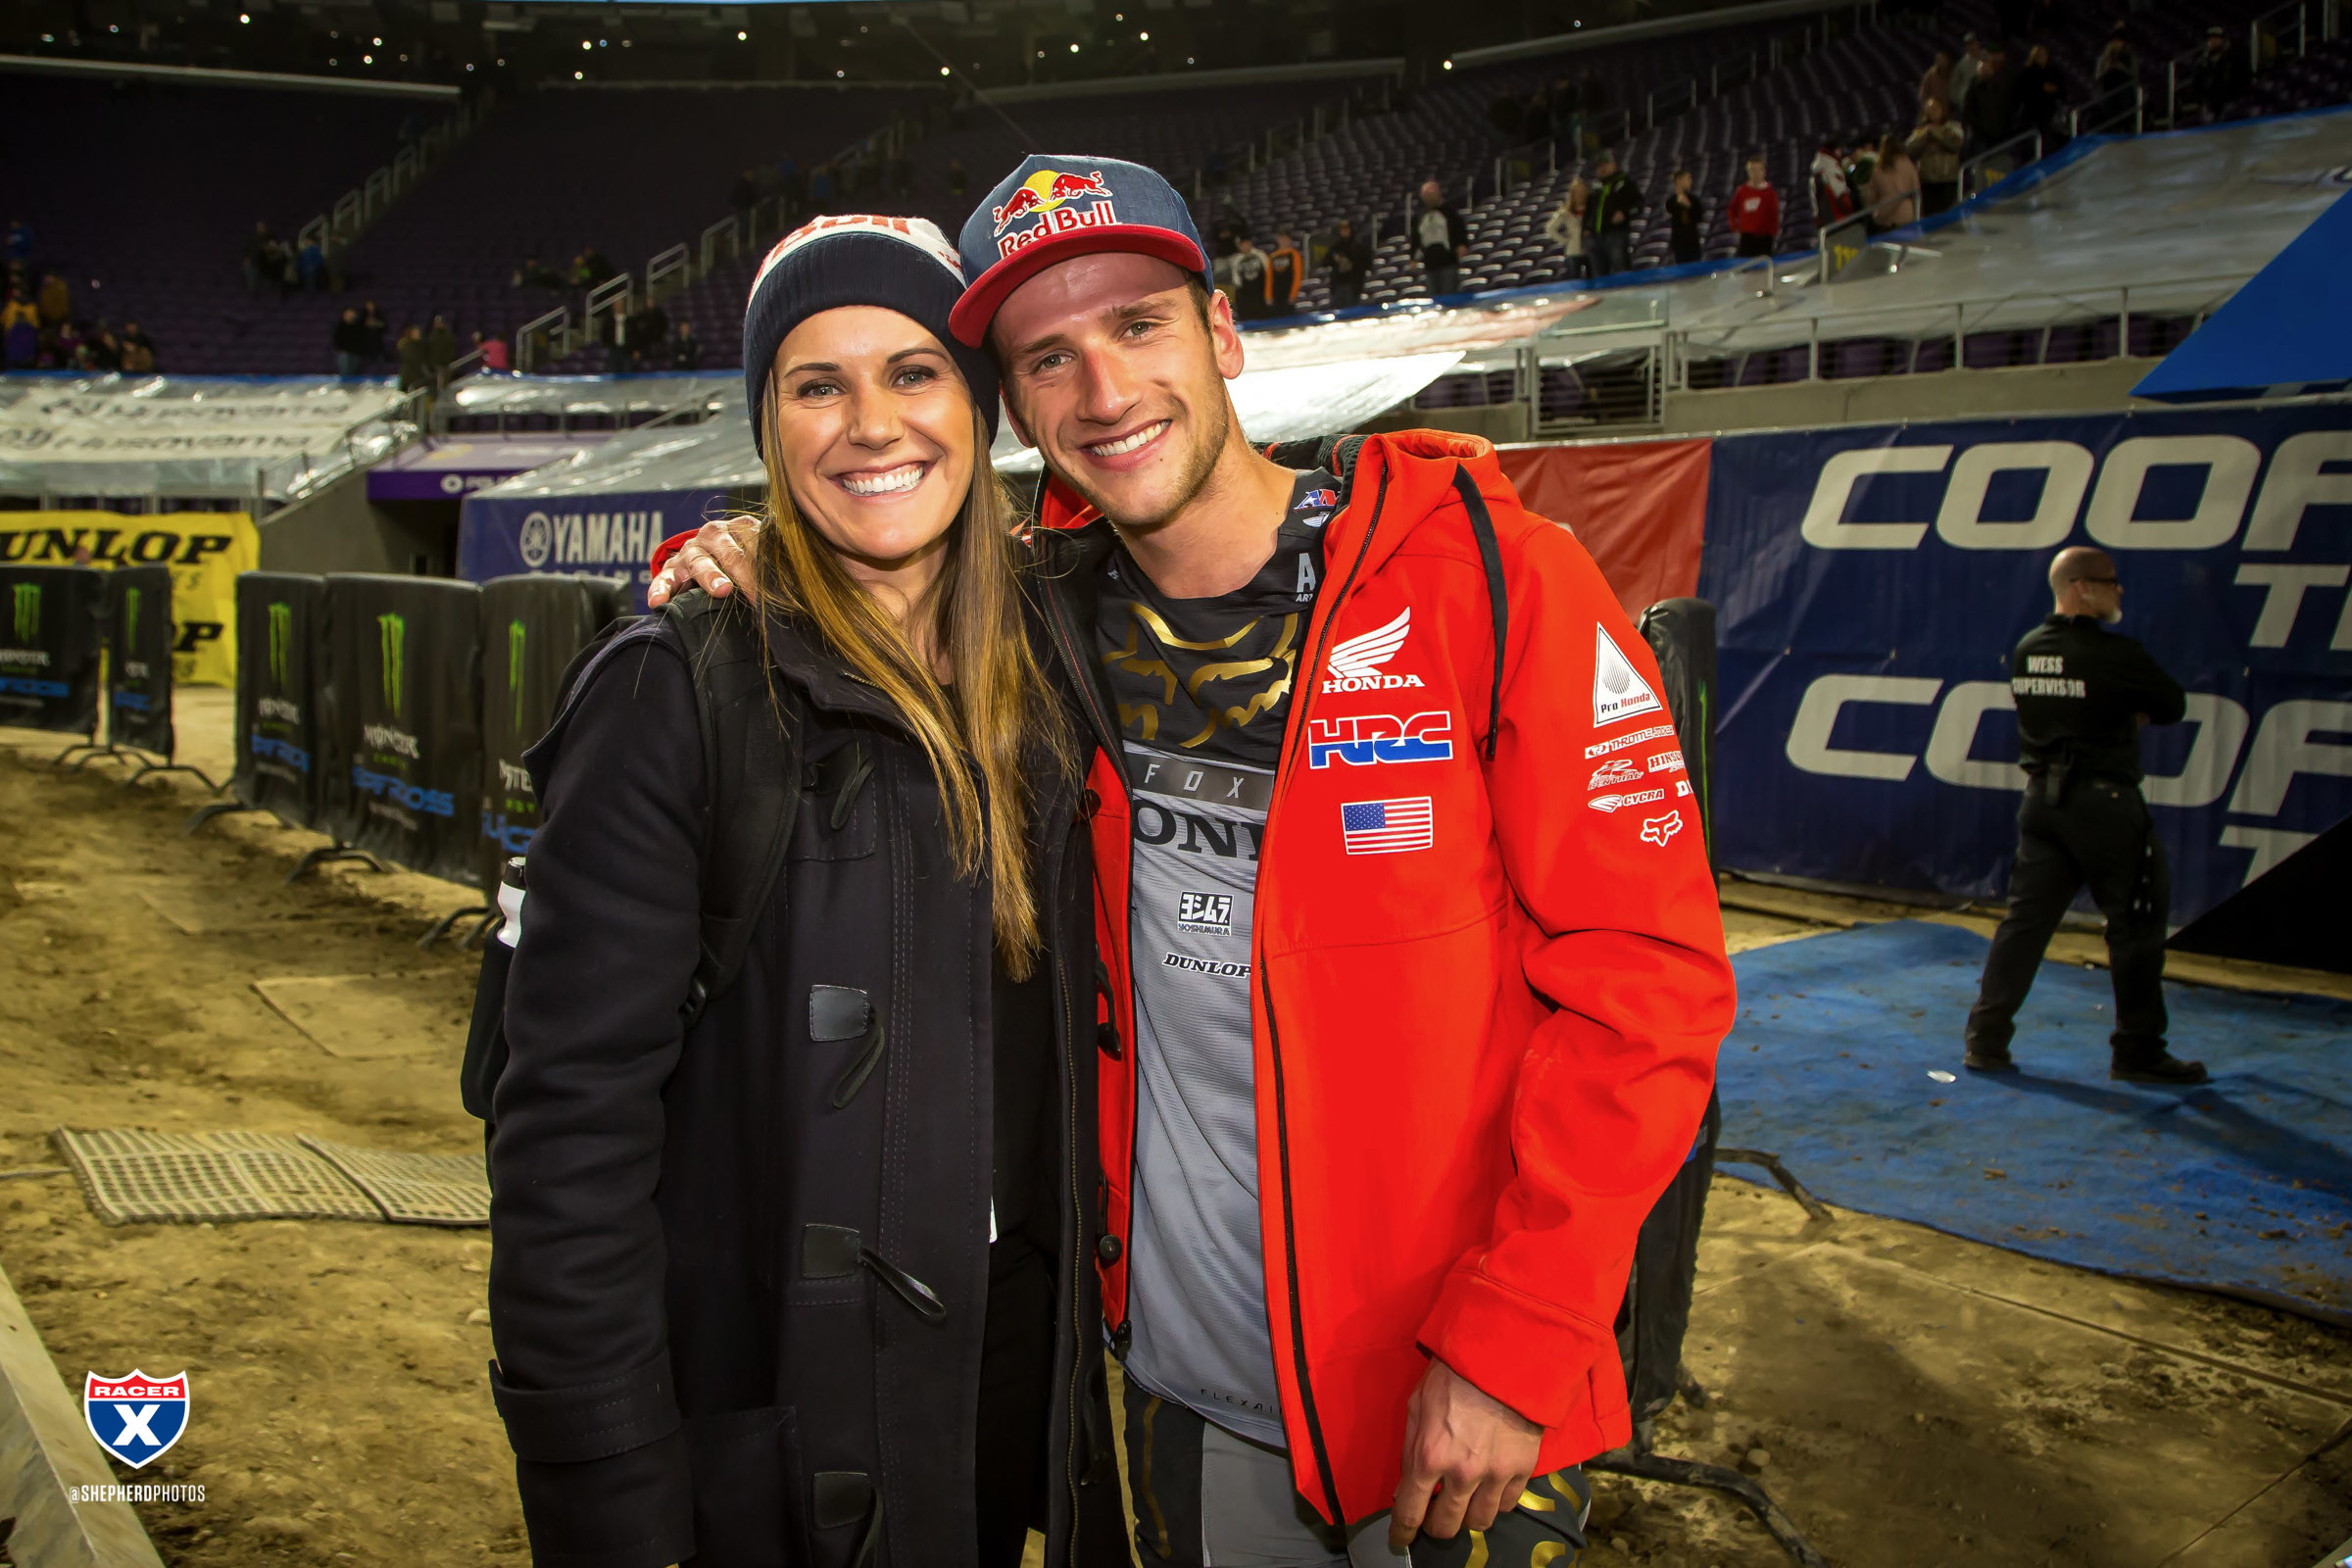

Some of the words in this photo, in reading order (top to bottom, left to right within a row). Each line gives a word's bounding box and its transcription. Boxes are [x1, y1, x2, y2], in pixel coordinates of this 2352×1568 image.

[998, 211, 1055, 259] Red
[1054, 200, 1118, 231] Bull
[0, 528, 233, 566] UNLOP
[552, 510, 664, 565] YAMAHA
[2027, 655, 2064, 674] WESS
[1322, 674, 1425, 694] HONDA
[1600, 702, 1619, 713] Pro
[1620, 692, 1651, 708] Honda
[1308, 710, 1453, 769] HRC
[1144, 763, 1245, 799] FOX
[1624, 789, 1664, 806] CYCRA
[1178, 923, 1231, 936] YOSHIMURA
[1162, 953, 1251, 978] DUNLOP
[1200, 1388, 1274, 1413] FLEXAI
